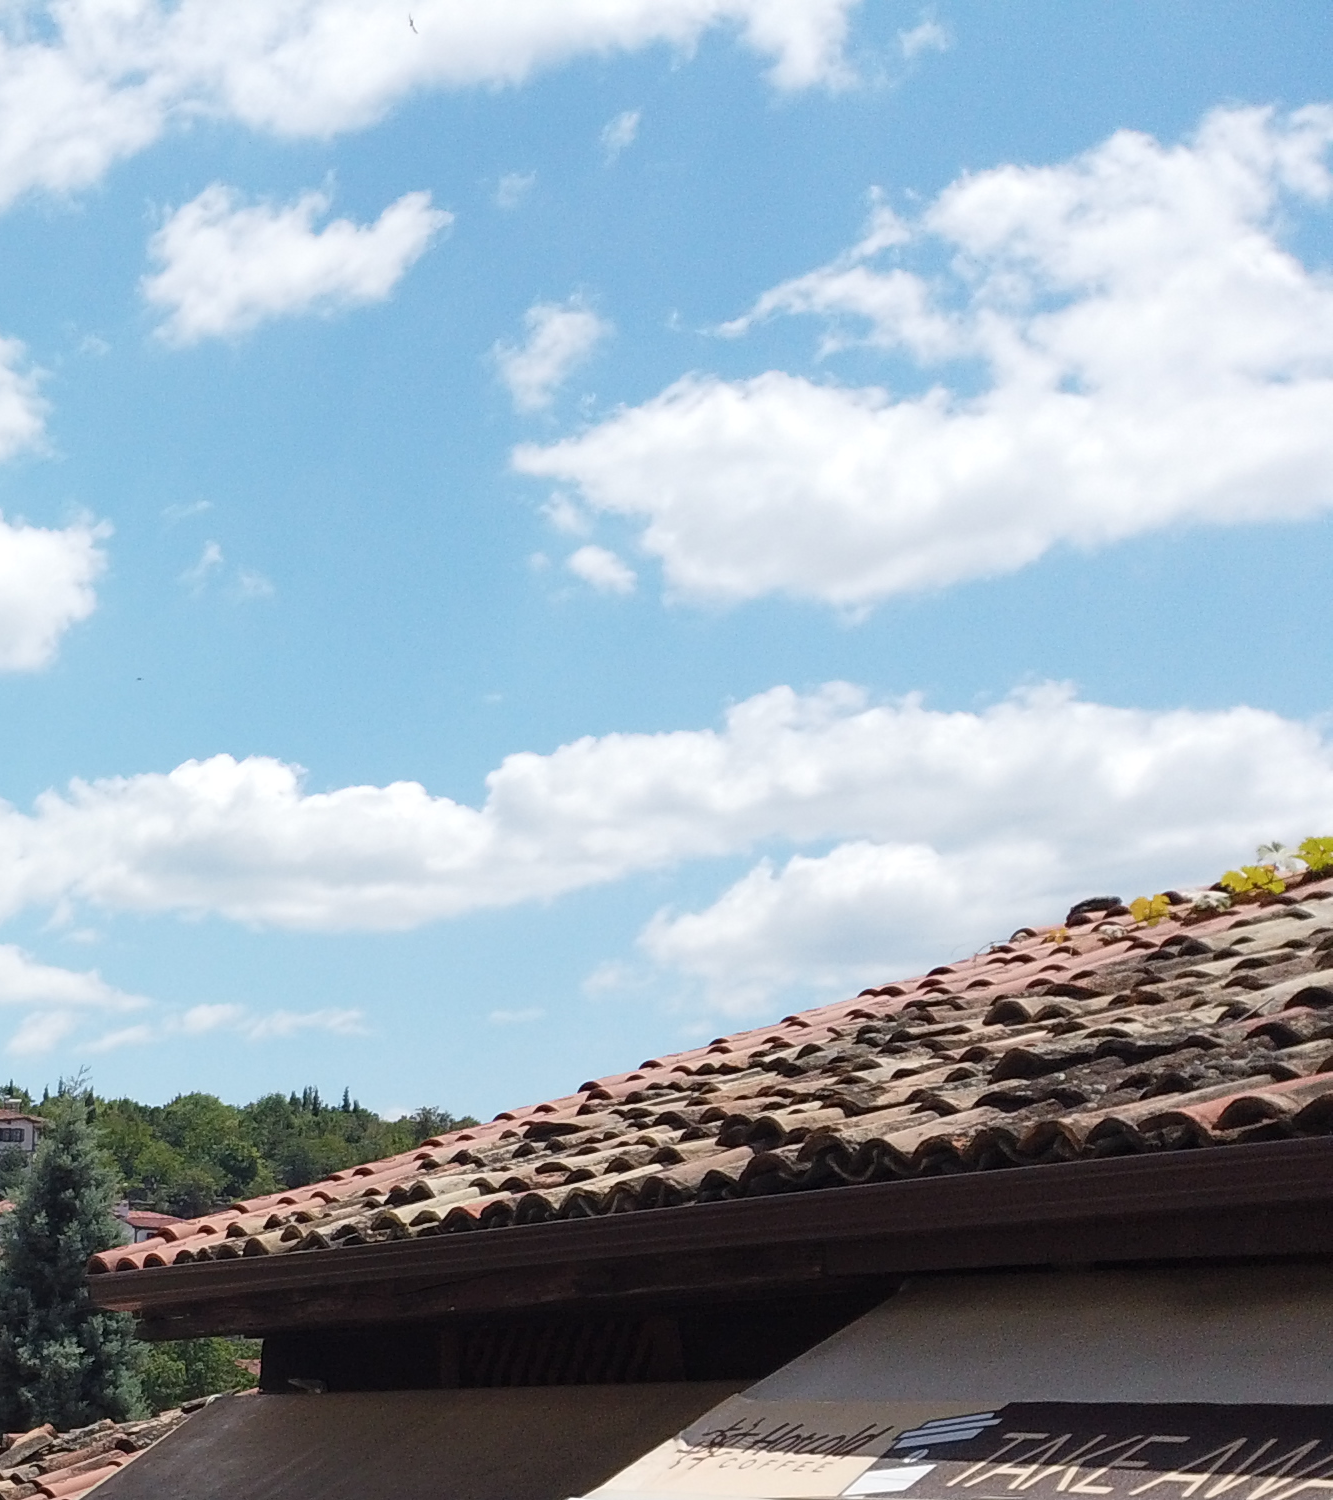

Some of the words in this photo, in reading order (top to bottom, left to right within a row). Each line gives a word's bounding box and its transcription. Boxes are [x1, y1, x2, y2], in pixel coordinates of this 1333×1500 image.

[742, 1421, 897, 1462] Hotcold
[717, 1455, 836, 1475] COFFEE
[945, 1431, 1190, 1494] TAKE
